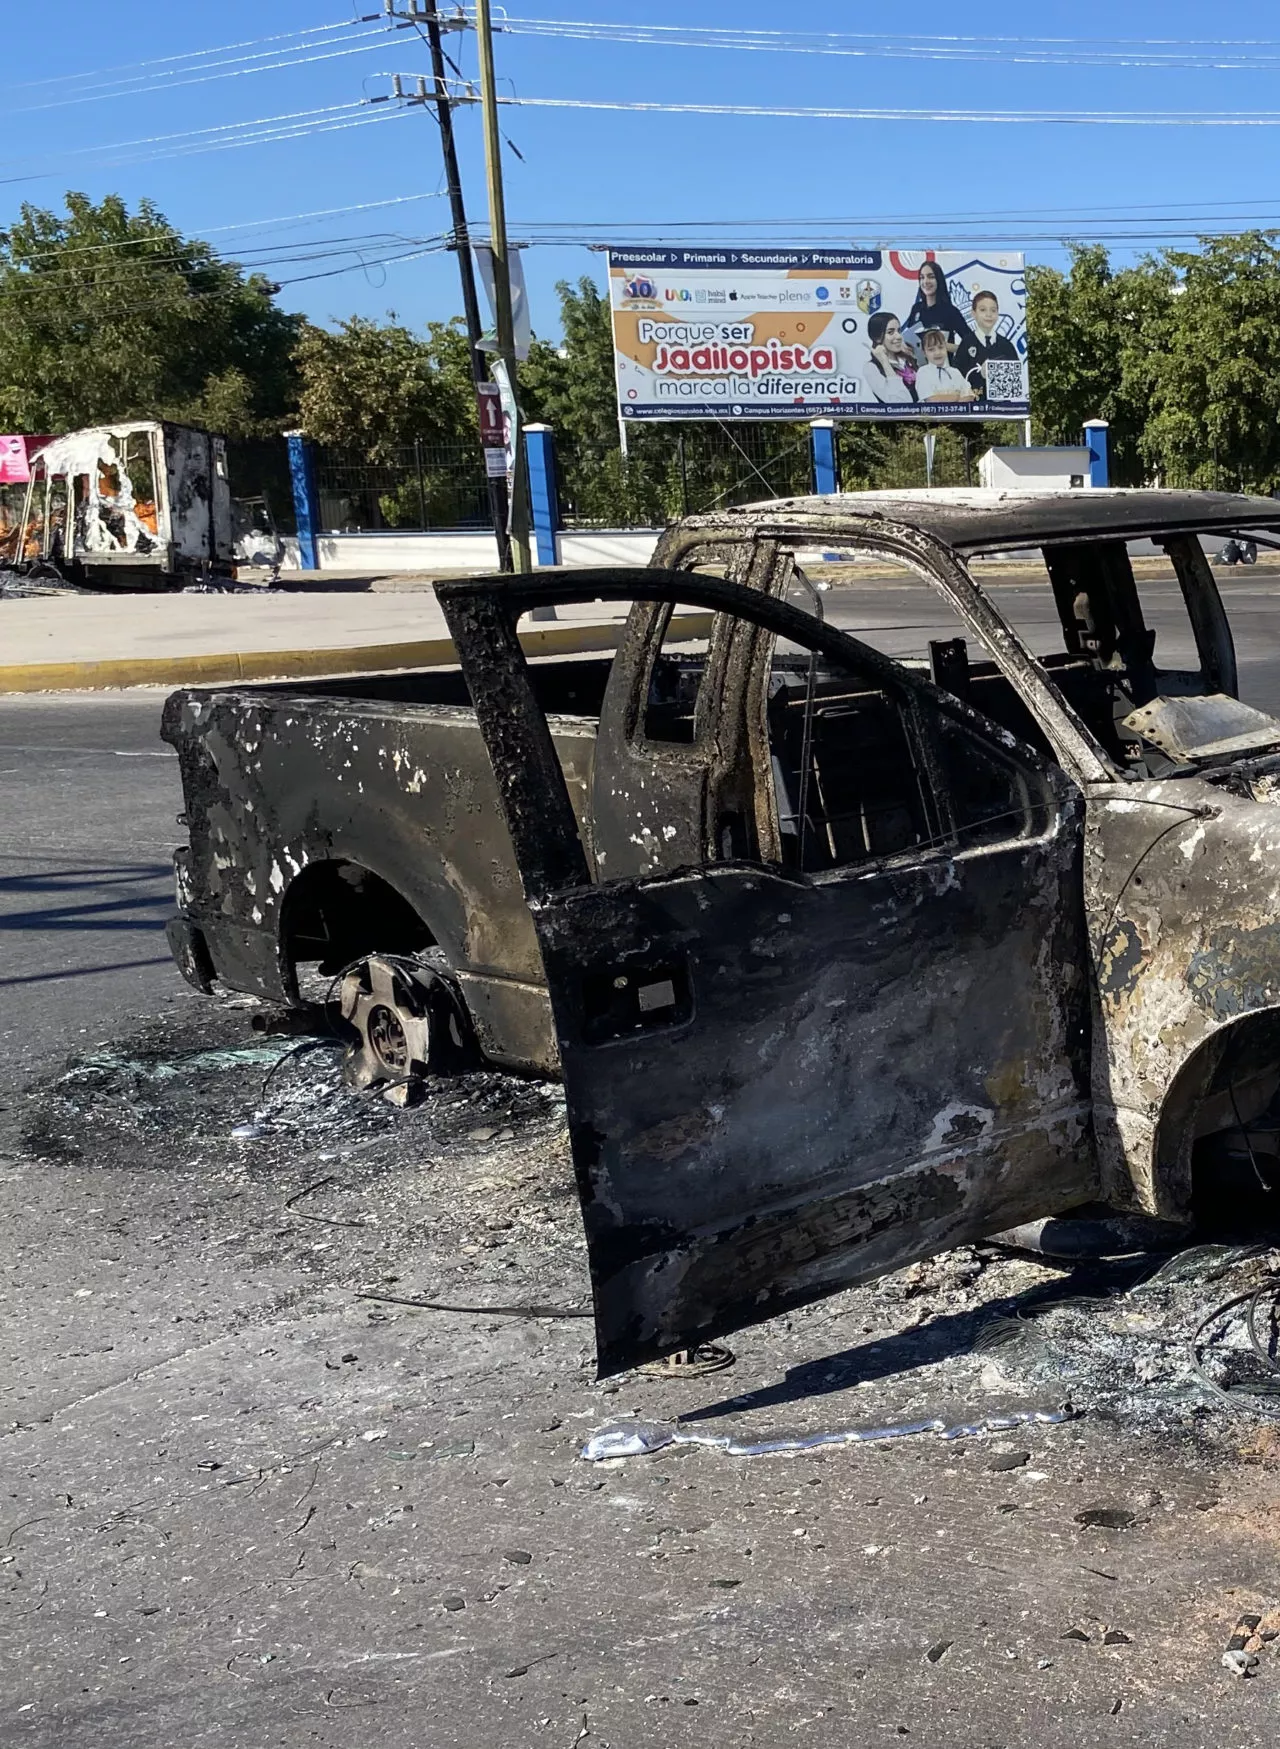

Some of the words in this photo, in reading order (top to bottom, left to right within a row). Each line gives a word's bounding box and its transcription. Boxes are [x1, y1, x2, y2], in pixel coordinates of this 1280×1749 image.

[611, 252, 666, 262] Preescolar
[683, 253, 726, 263] Primaria
[741, 253, 798, 264] Secundaria
[812, 254, 874, 265] Preparatoria
[779, 290, 811, 303] pleno
[642, 323, 715, 342] Porque
[721, 326, 751, 339] ser
[659, 382, 727, 395] marca
[733, 379, 751, 395] la
[757, 378, 857, 395] diferencia
[743, 407, 770, 415] Campus
[860, 406, 886, 414] Campus
[887, 406, 920, 414] Guadalupe
